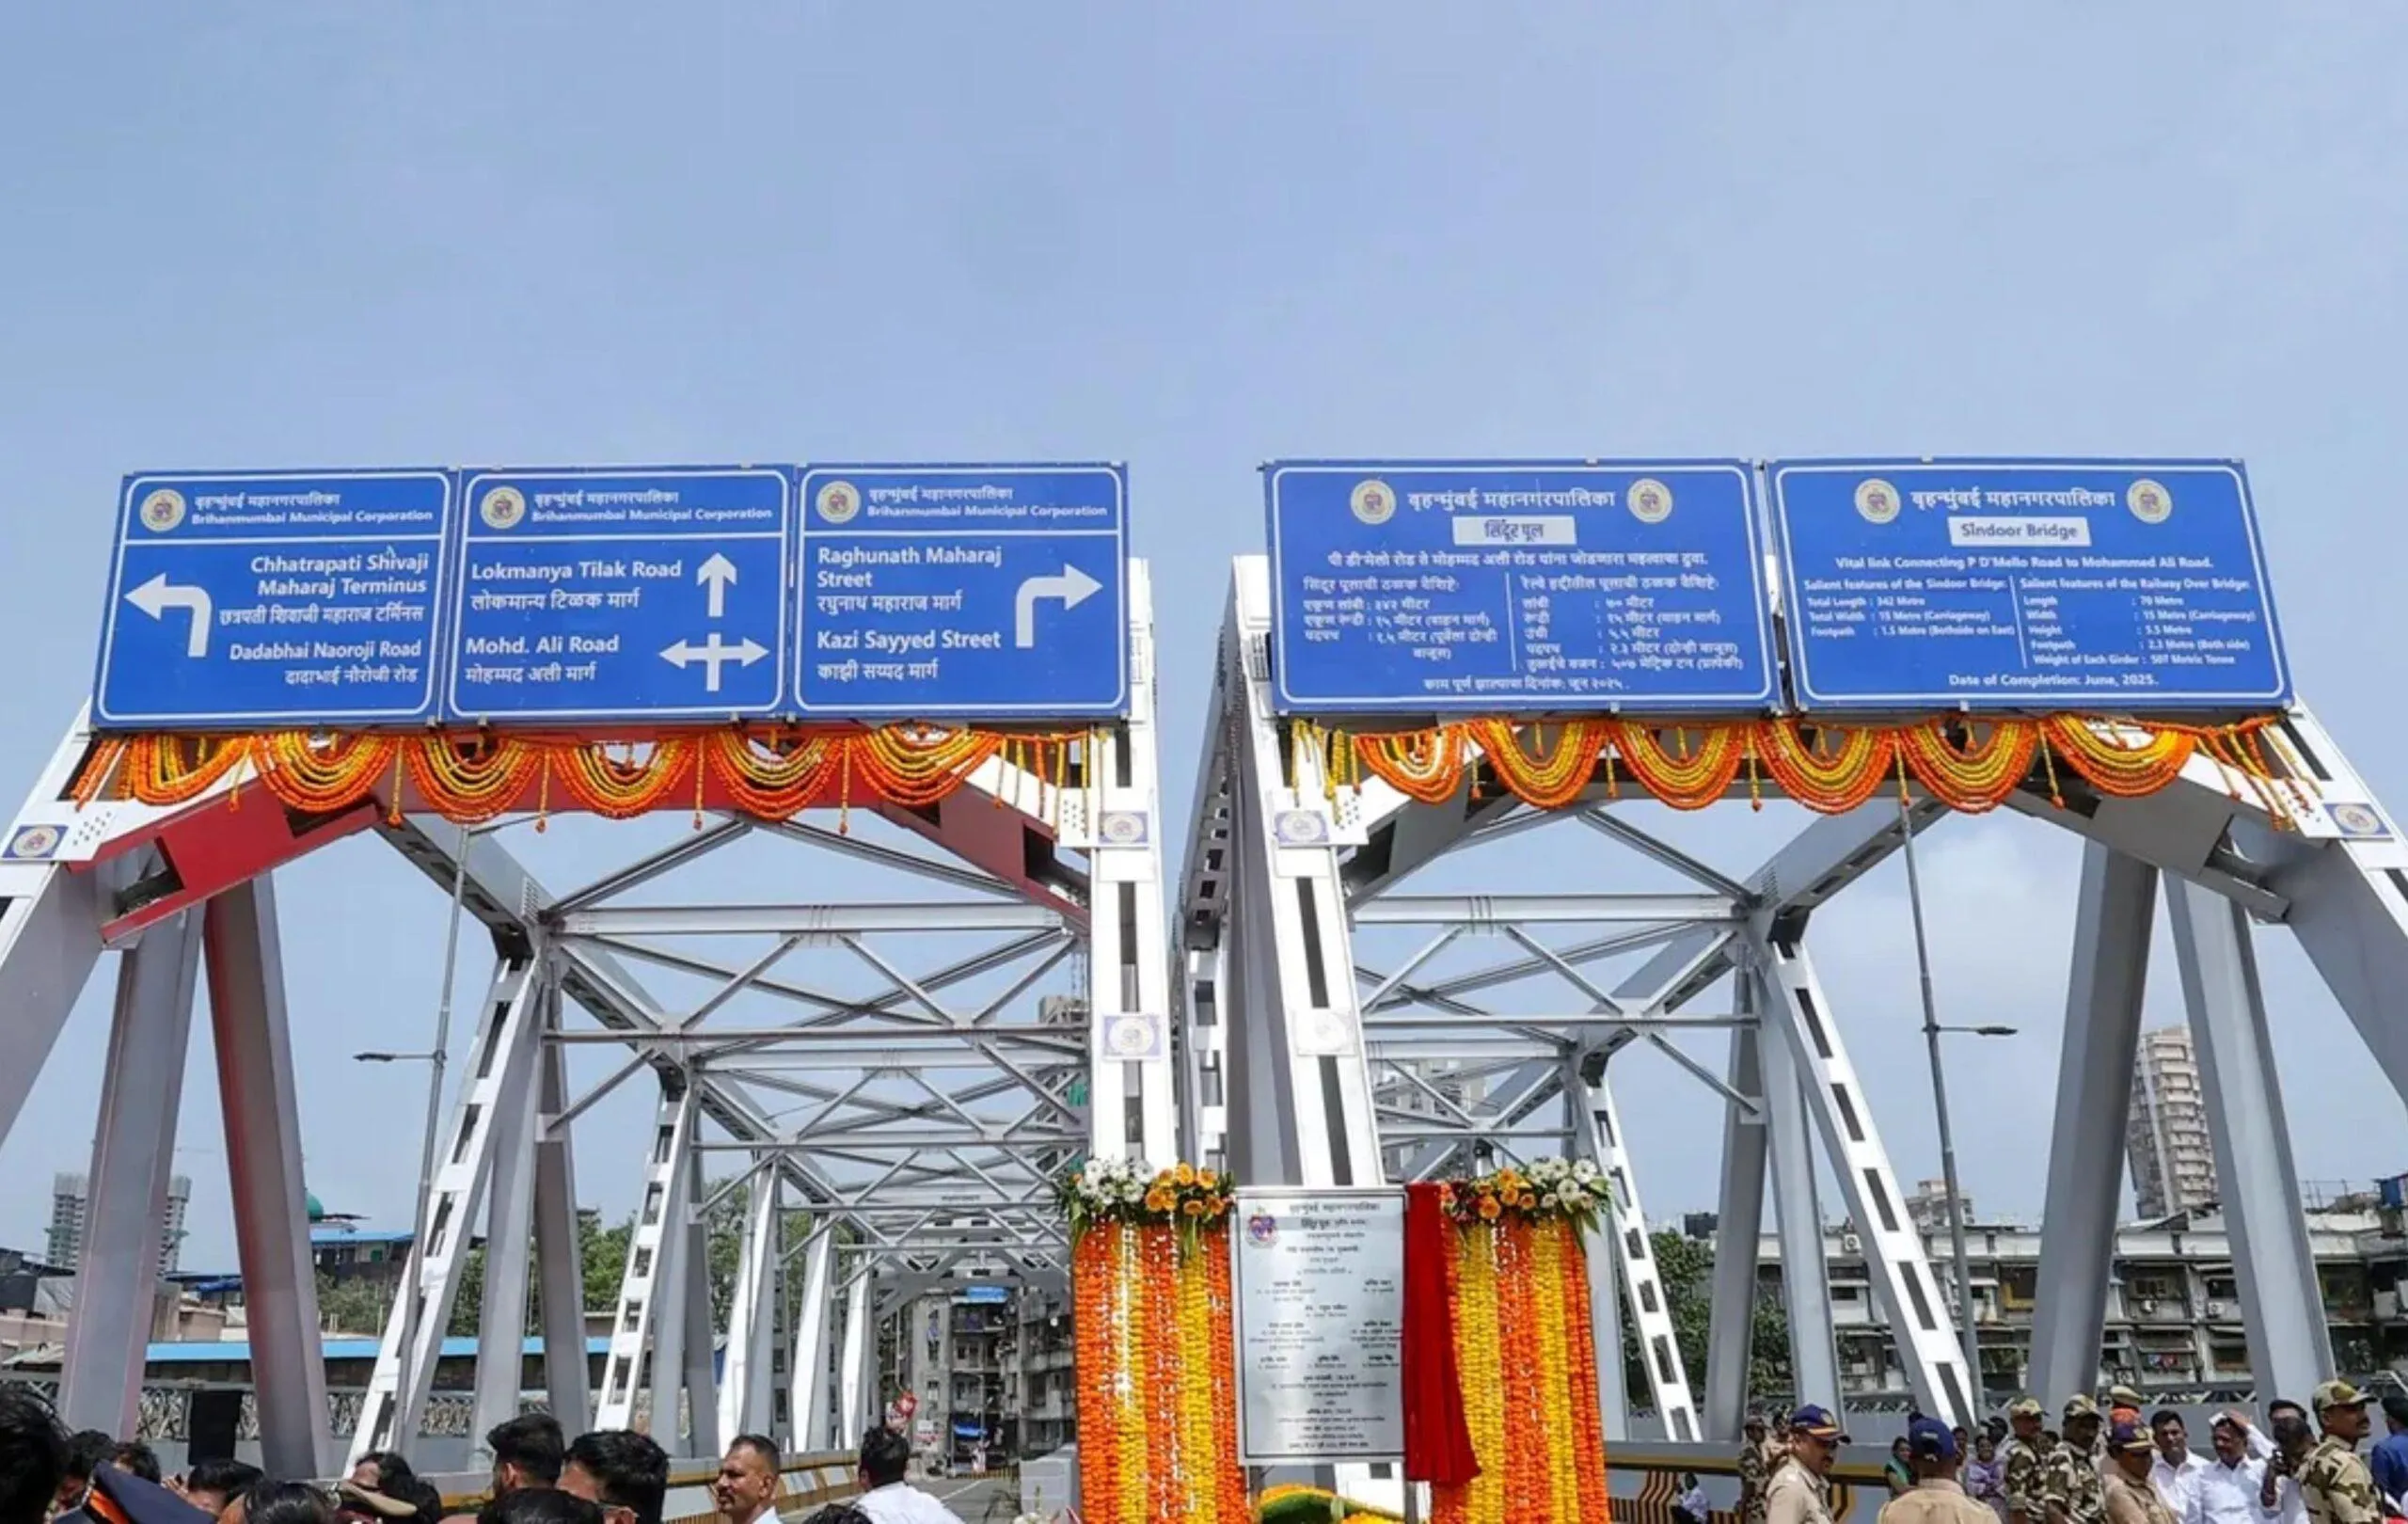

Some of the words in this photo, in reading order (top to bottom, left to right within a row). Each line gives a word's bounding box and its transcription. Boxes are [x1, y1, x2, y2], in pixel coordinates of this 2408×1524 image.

[247, 491, 341, 508] महानगरपालिका
[586, 489, 678, 505] महानगरपालिका
[921, 485, 1012, 501] महानगरपालिका
[1482, 486, 1615, 508] महानगरपालिका
[1985, 487, 2115, 508] महानगरपालिका
[192, 513, 286, 524] Brihanmumbai
[290, 511, 353, 524] Municipal
[355, 511, 433, 523] Corporation
[531, 510, 626, 521] Brihanmumbai
[629, 509, 691, 522] Municipal
[695, 508, 772, 521] Corporation
[867, 506, 961, 516] Brihanmumbai
[964, 505, 1027, 517] Municipal
[1030, 505, 1107, 518] Corporation
[1960, 522, 2021, 537] Sindoor
[2026, 523, 2077, 540] Bridge
[251, 555, 362, 576] Chhatrapati
[367, 553, 428, 574] Shivaji
[818, 547, 920, 568] Raghunath
[927, 547, 1001, 567] Maharaj
[1836, 558, 1865, 569] Vital
[1893, 557, 1965, 570] Connecting
[2066, 558, 2079, 567] to
[2082, 557, 2157, 567] Mohammed
[472, 563, 572, 583] Lokmanya
[578, 561, 626, 578] Tilak
[632, 561, 681, 578] Road
[817, 570, 872, 587] Street
[258, 579, 335, 598] Maharaj
[341, 578, 427, 594] Terminus
[1890, 579, 1902, 589] of
[1904, 579, 1923, 589] the
[2105, 578, 2117, 588] of
[2119, 579, 2137, 589] the
[470, 589, 547, 610] लोकमान्य
[550, 589, 604, 609] टिळक
[607, 587, 640, 607] मार्ग
[816, 595, 868, 615] रघुनाथ
[871, 595, 928, 612] महाराज
[931, 589, 962, 610] मार्ग
[322, 607, 373, 624] महाराज
[466, 637, 530, 654] Mohd.
[536, 636, 562, 653] Ali
[569, 635, 619, 653] Road
[817, 630, 858, 648] Kazi
[865, 630, 935, 654] Sayyed
[942, 629, 1001, 648] Street
[230, 643, 309, 659] Dadabhai
[313, 641, 375, 661] Naoroji
[380, 640, 421, 657] Road
[908, 658, 938, 678] मार्ग
[2071, 655, 2083, 664] of
[393, 666, 419, 682] रोड
[466, 663, 524, 684] मोहम्मद
[528, 662, 562, 681] अली
[565, 661, 596, 681] मार्ग
[1949, 675, 1980, 686] Date
[1983, 675, 1997, 686] of
[2122, 674, 2158, 686] 2025.
